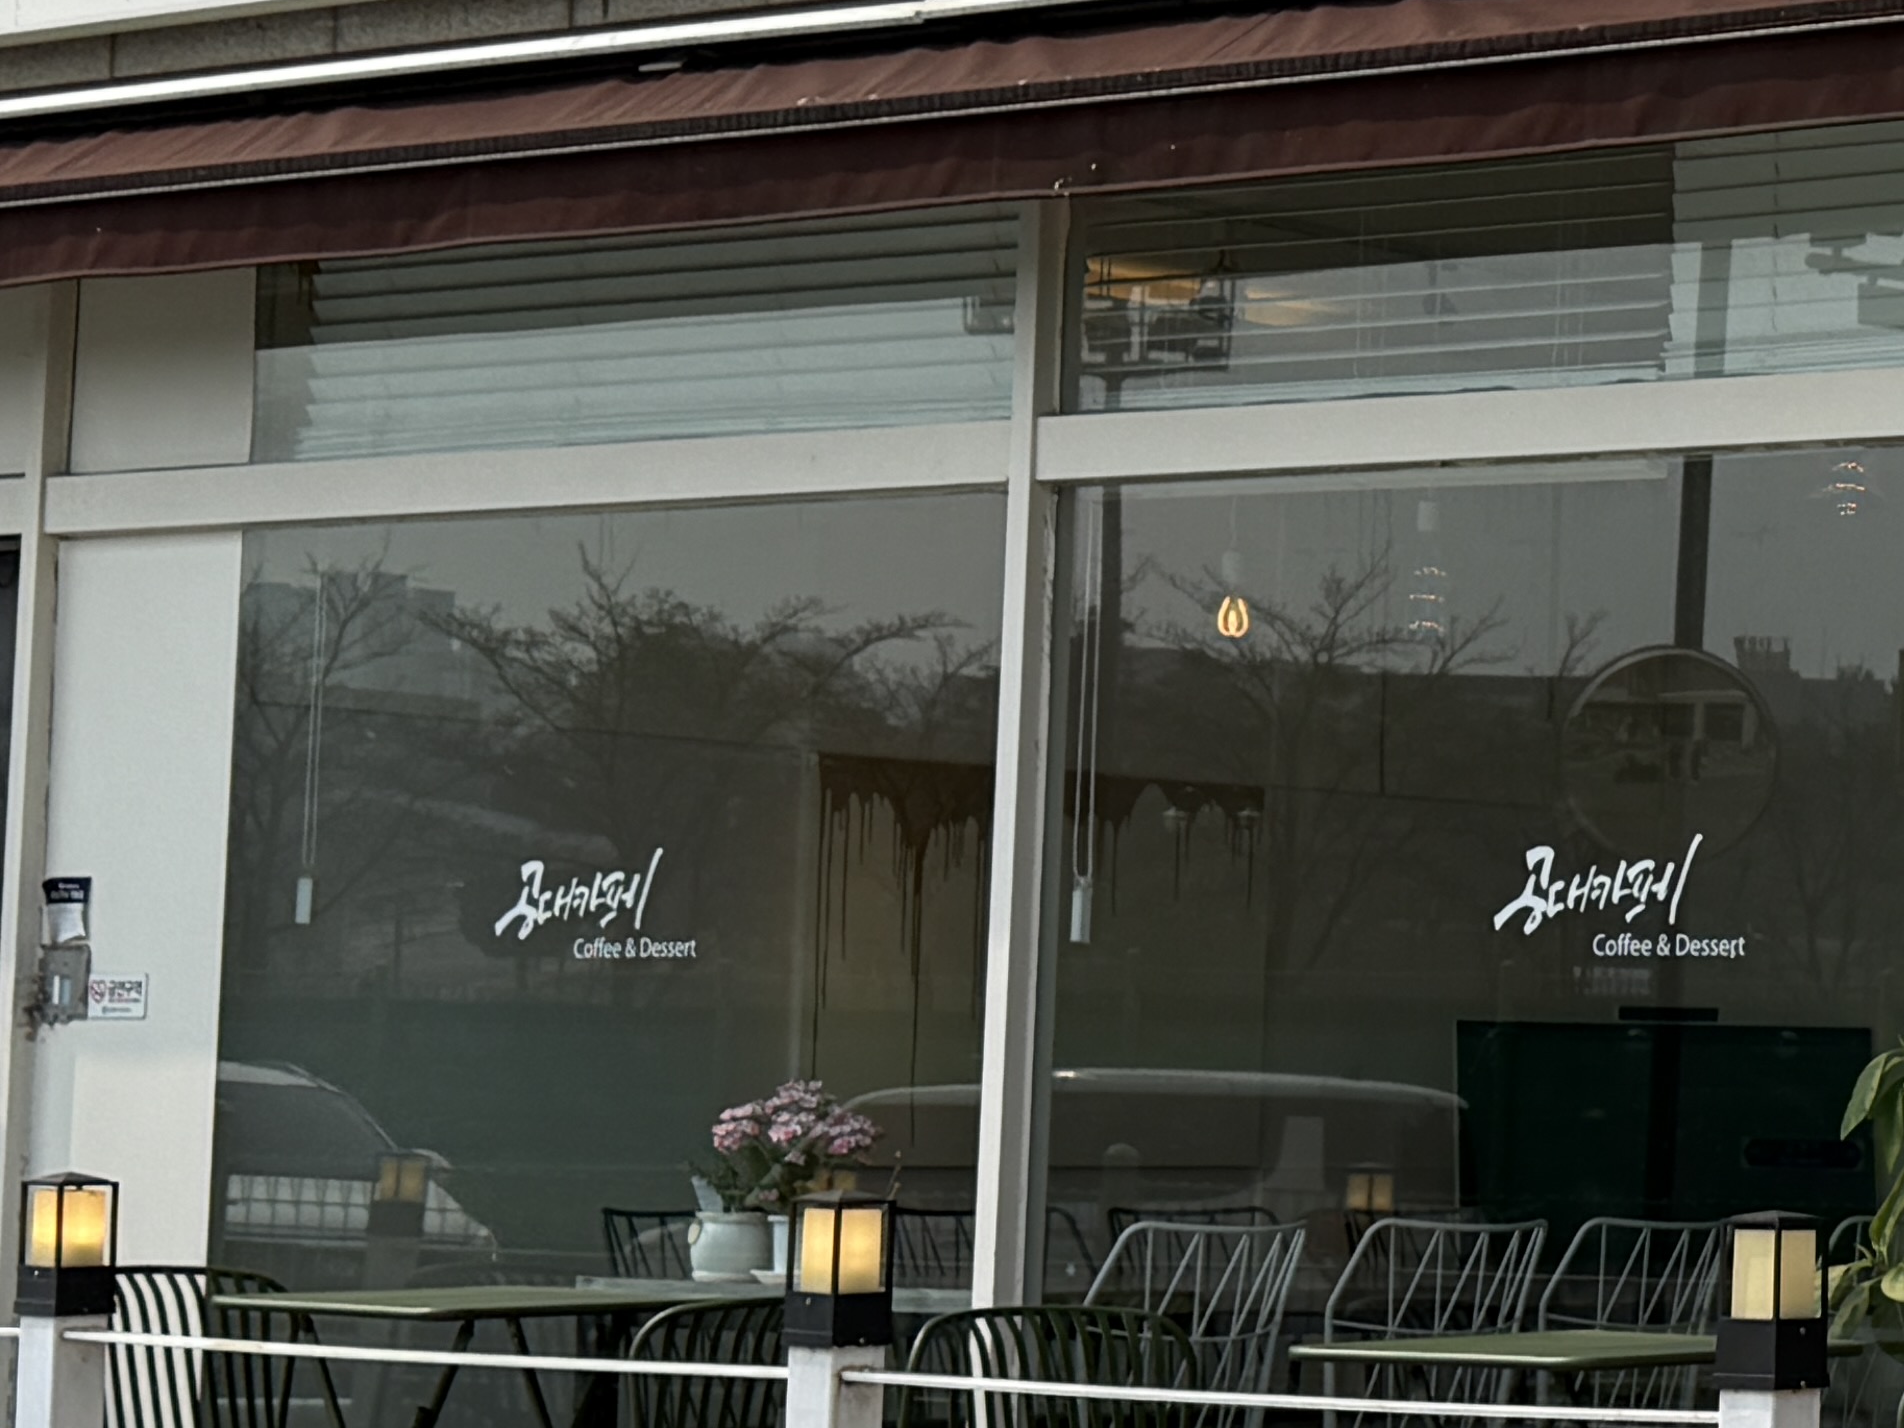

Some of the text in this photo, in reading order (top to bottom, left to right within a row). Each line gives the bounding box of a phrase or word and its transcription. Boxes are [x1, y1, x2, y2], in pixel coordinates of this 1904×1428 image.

[494, 847, 665, 941] 공대카페
[1493, 833, 1704, 935] 공대카페
[573, 936, 697, 959] Coffee & Dessert
[1592, 932, 1746, 959] Coffee & Dessert
